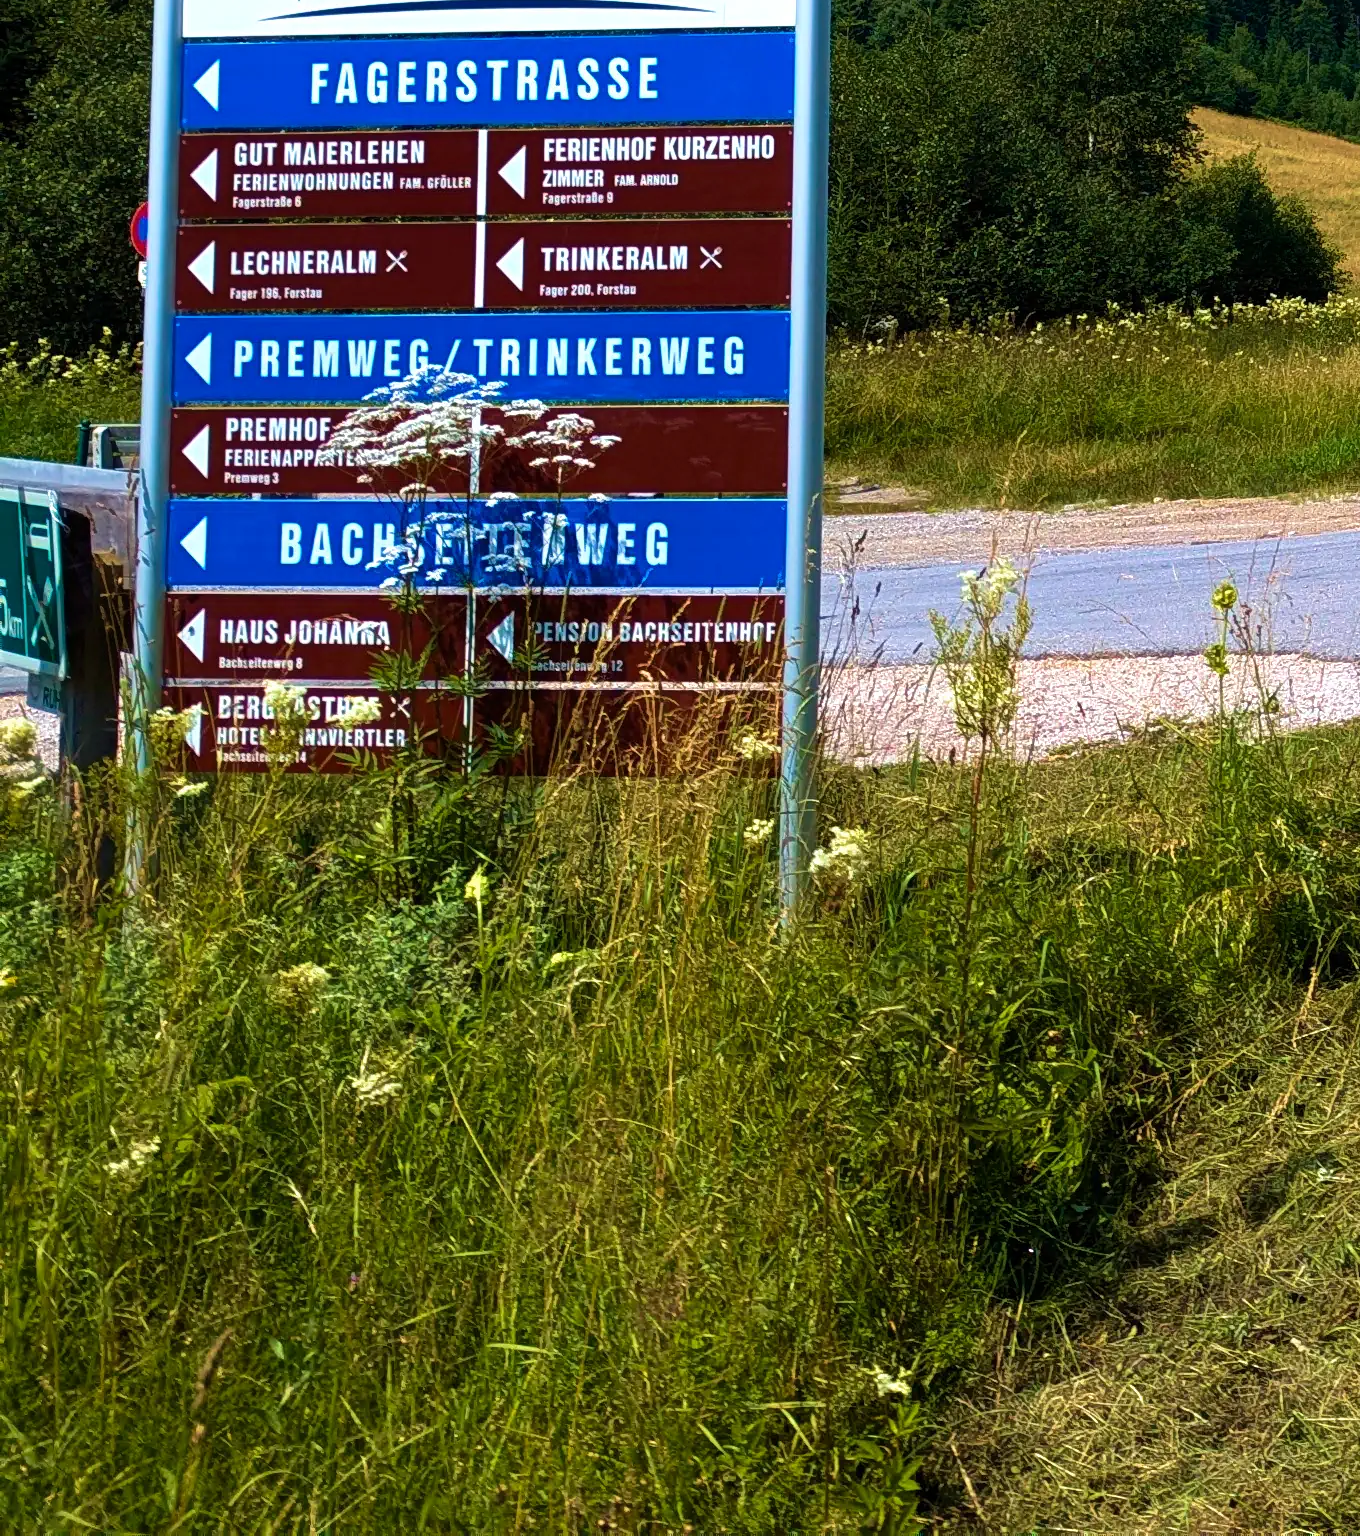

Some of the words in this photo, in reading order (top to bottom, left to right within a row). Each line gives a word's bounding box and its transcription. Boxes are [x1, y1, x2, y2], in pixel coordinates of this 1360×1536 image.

[311, 57, 659, 105] FAGERSTRASSE
[234, 142, 277, 167] GUT
[283, 140, 425, 166] MAIERLEHEN
[543, 136, 657, 163] FERIENHOF
[664, 135, 775, 161] KURZENHO
[233, 172, 394, 192] FERIENWOHNUNGEN
[400, 178, 425, 190] FAM.
[427, 174, 472, 189] GFÖLLER
[542, 169, 605, 188] ZIMMER
[614, 175, 638, 187] FAM.
[640, 173, 679, 186] ARNOLD
[232, 196, 293, 210] Fagerstraße
[294, 195, 302, 208] 6
[542, 192, 605, 205] Fagerstraße
[607, 191, 614, 204] 9
[230, 249, 377, 276] LECHNERALM
[541, 245, 689, 272] TRINKERALM
[230, 287, 258, 301] Fager
[284, 286, 323, 300] Forstau
[539, 284, 569, 298] Fager
[597, 283, 637, 297] Forstau
[234, 338, 430, 378] PREMWEG
[473, 336, 745, 377] TRINKERWEG
[226, 416, 331, 442] PREMHOF
[224, 471, 271, 486] Premweg
[272, 472, 280, 484] 3
[219, 619, 279, 644] HAUS
[284, 619, 391, 646] JOHANNA
[619, 621, 777, 643] BACHSEITENHOF
[218, 656, 294, 671] Bachseitenweg
[296, 657, 304, 670] 8
[611, 659, 624, 672] 12
[216, 726, 268, 746] HOTE
